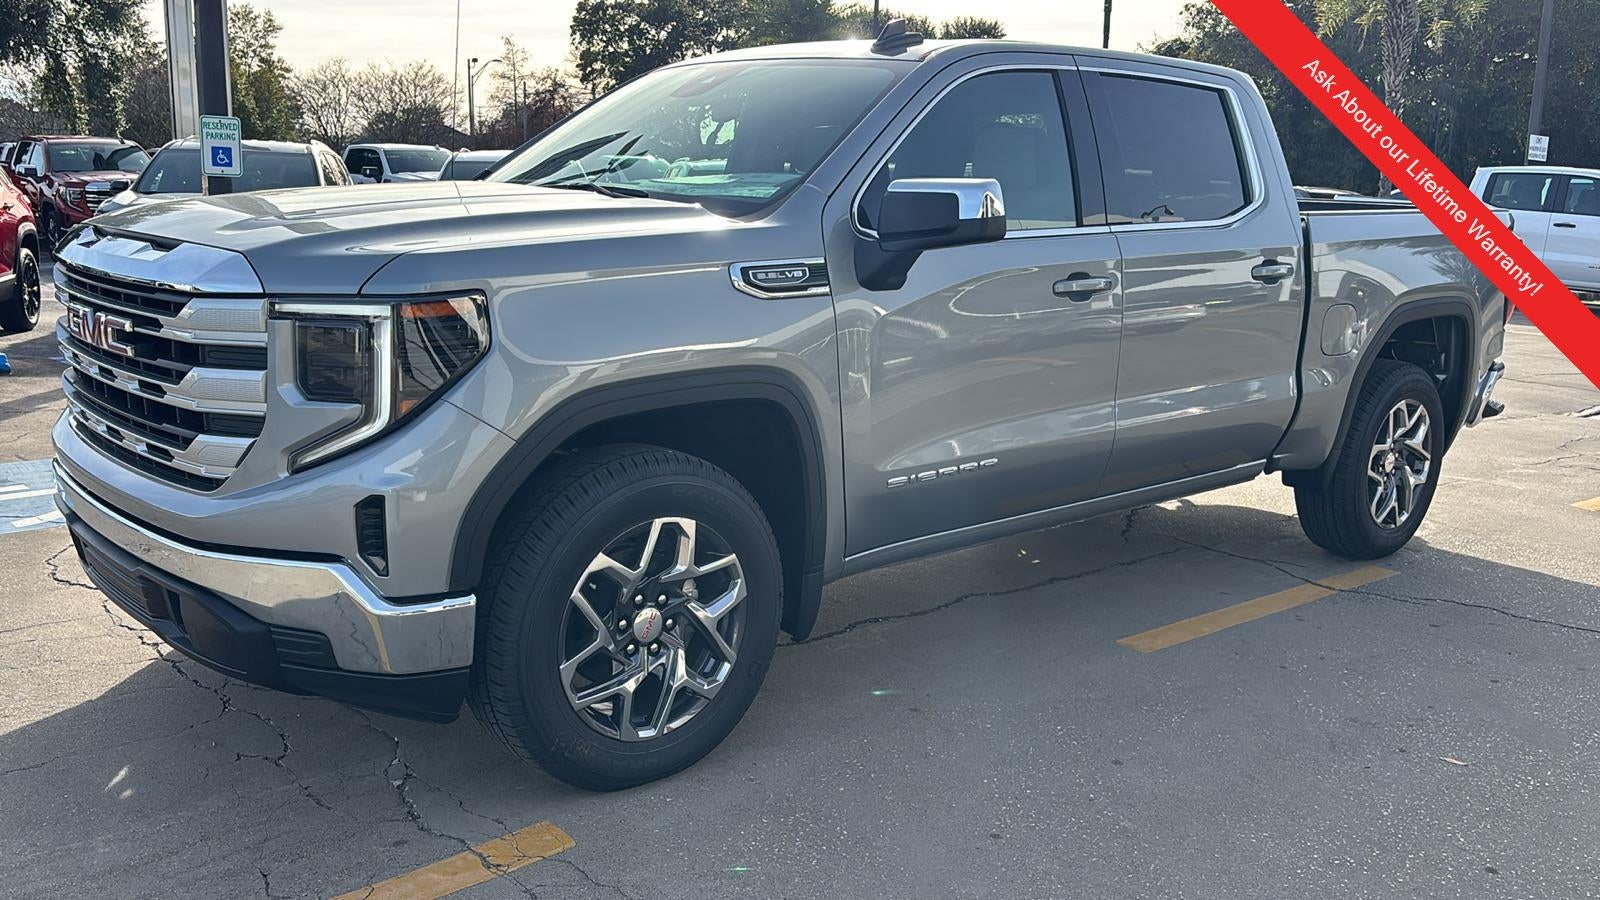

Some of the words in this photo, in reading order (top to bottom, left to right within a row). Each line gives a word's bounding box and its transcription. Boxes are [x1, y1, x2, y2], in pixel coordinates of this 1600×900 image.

[202, 121, 238, 131] RESERVED
[205, 132, 237, 141] PARKING
[66, 301, 135, 358] GMC
[886, 457, 999, 489] SIERRA
[641, 611, 658, 640] GMC
